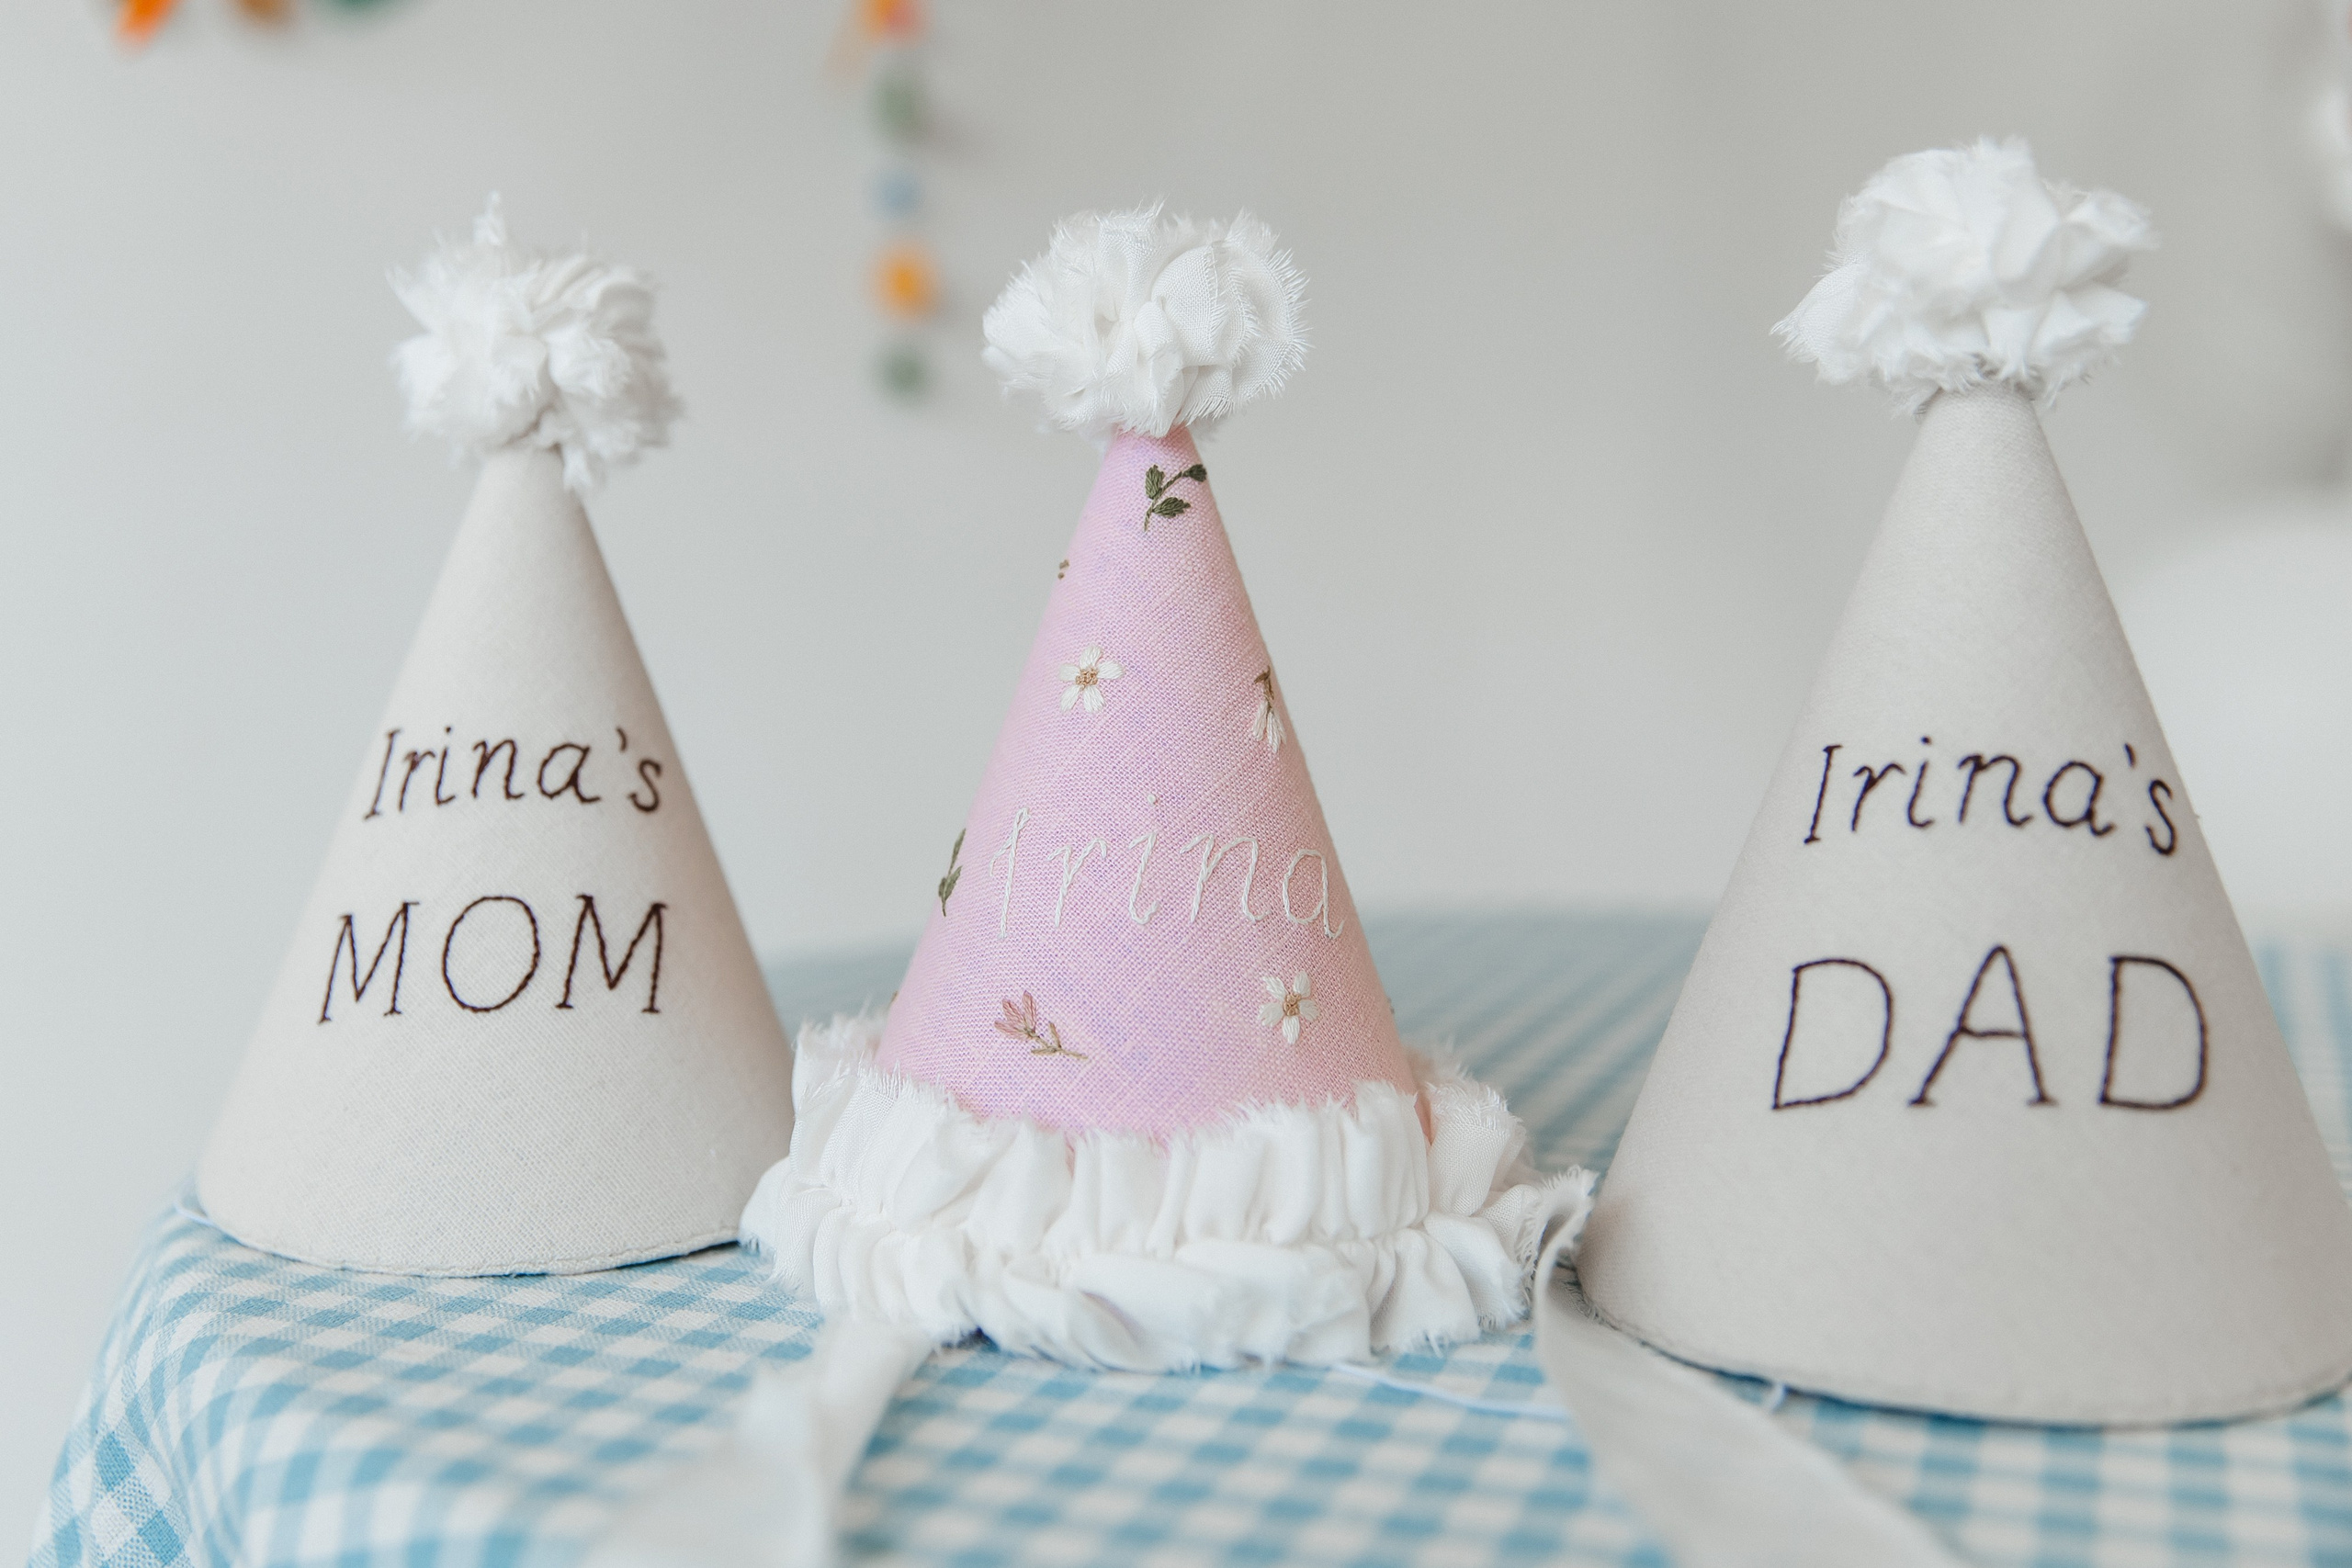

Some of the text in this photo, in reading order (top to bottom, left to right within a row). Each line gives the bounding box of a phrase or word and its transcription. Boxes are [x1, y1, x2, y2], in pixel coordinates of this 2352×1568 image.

[364, 726, 662, 820] Irina's
[1804, 736, 2177, 857] Irina's
[989, 794, 1344, 939] Irina
[317, 894, 670, 1024] MOM
[1771, 945, 2210, 1111] DAD
